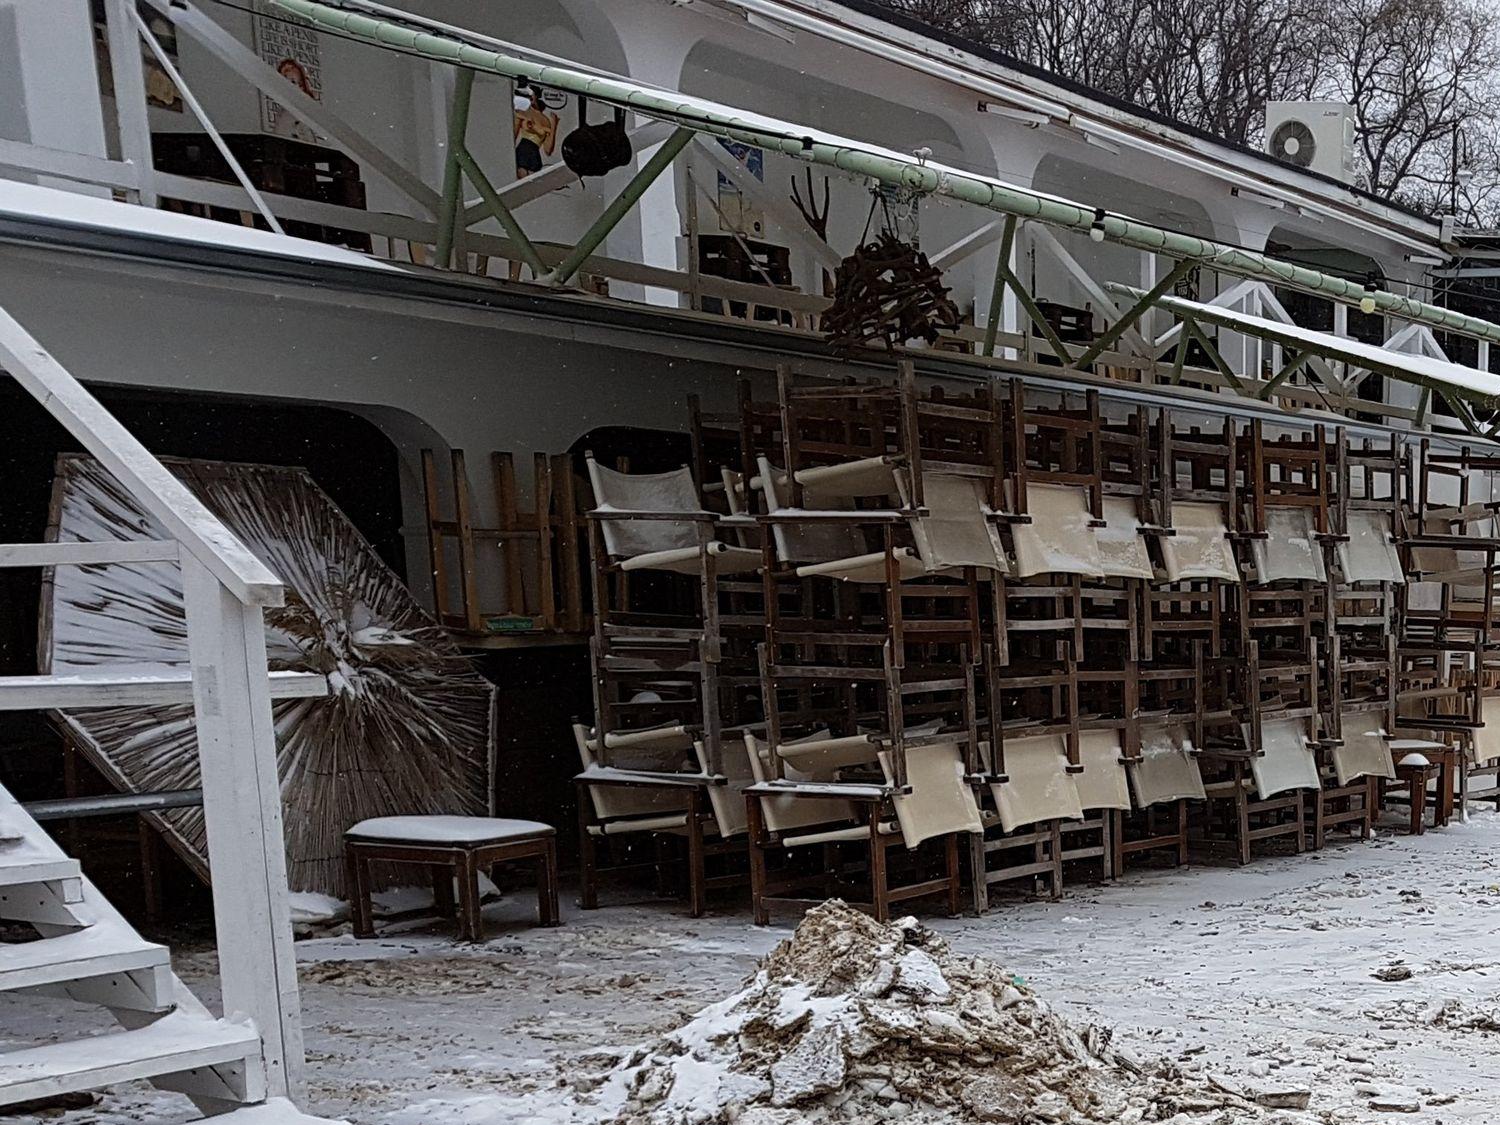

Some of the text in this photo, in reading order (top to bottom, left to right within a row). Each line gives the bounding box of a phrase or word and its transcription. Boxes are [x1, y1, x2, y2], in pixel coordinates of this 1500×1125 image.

[259, 16, 283, 33] LIKE
[290, 24, 318, 43] PENIS
[260, 39, 285, 57] LIKE
[292, 48, 320, 67] PENIS
